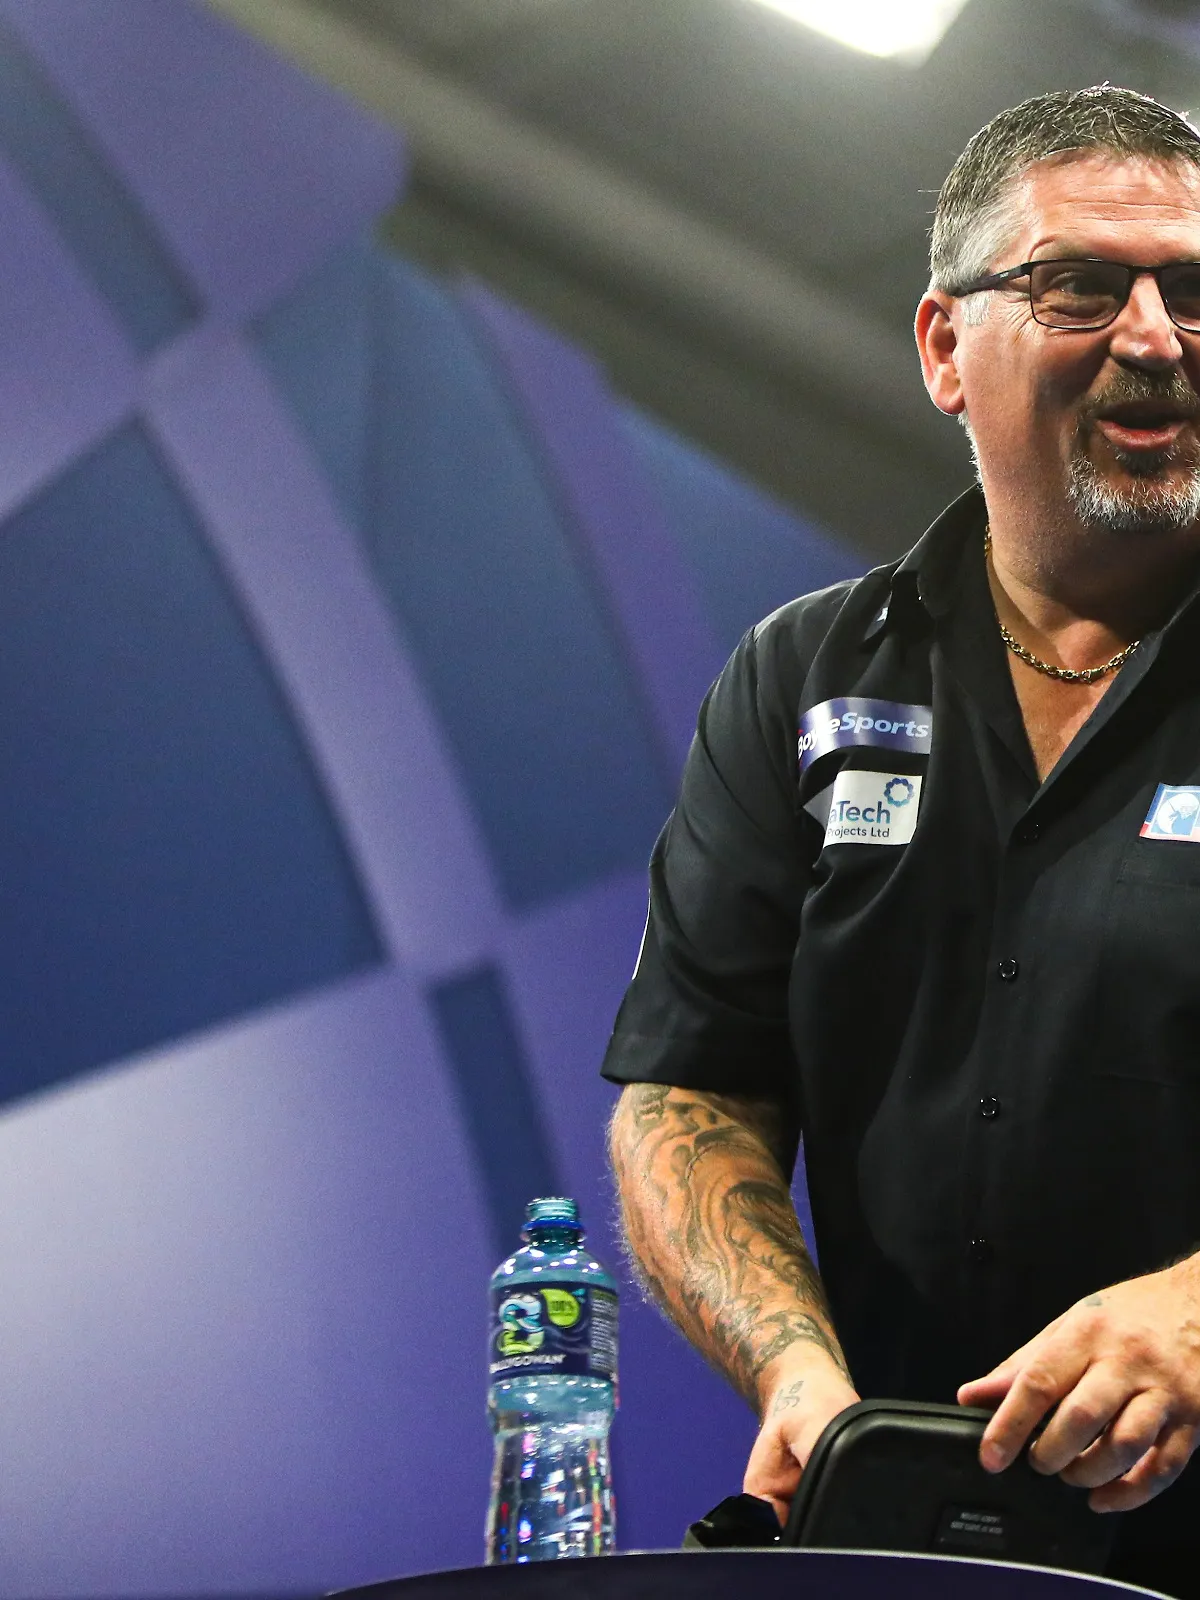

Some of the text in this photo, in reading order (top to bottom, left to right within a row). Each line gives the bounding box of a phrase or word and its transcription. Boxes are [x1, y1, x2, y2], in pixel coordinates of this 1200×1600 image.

[797, 712, 928, 760] BoyeSports
[827, 826, 890, 839] Projects Ltd
